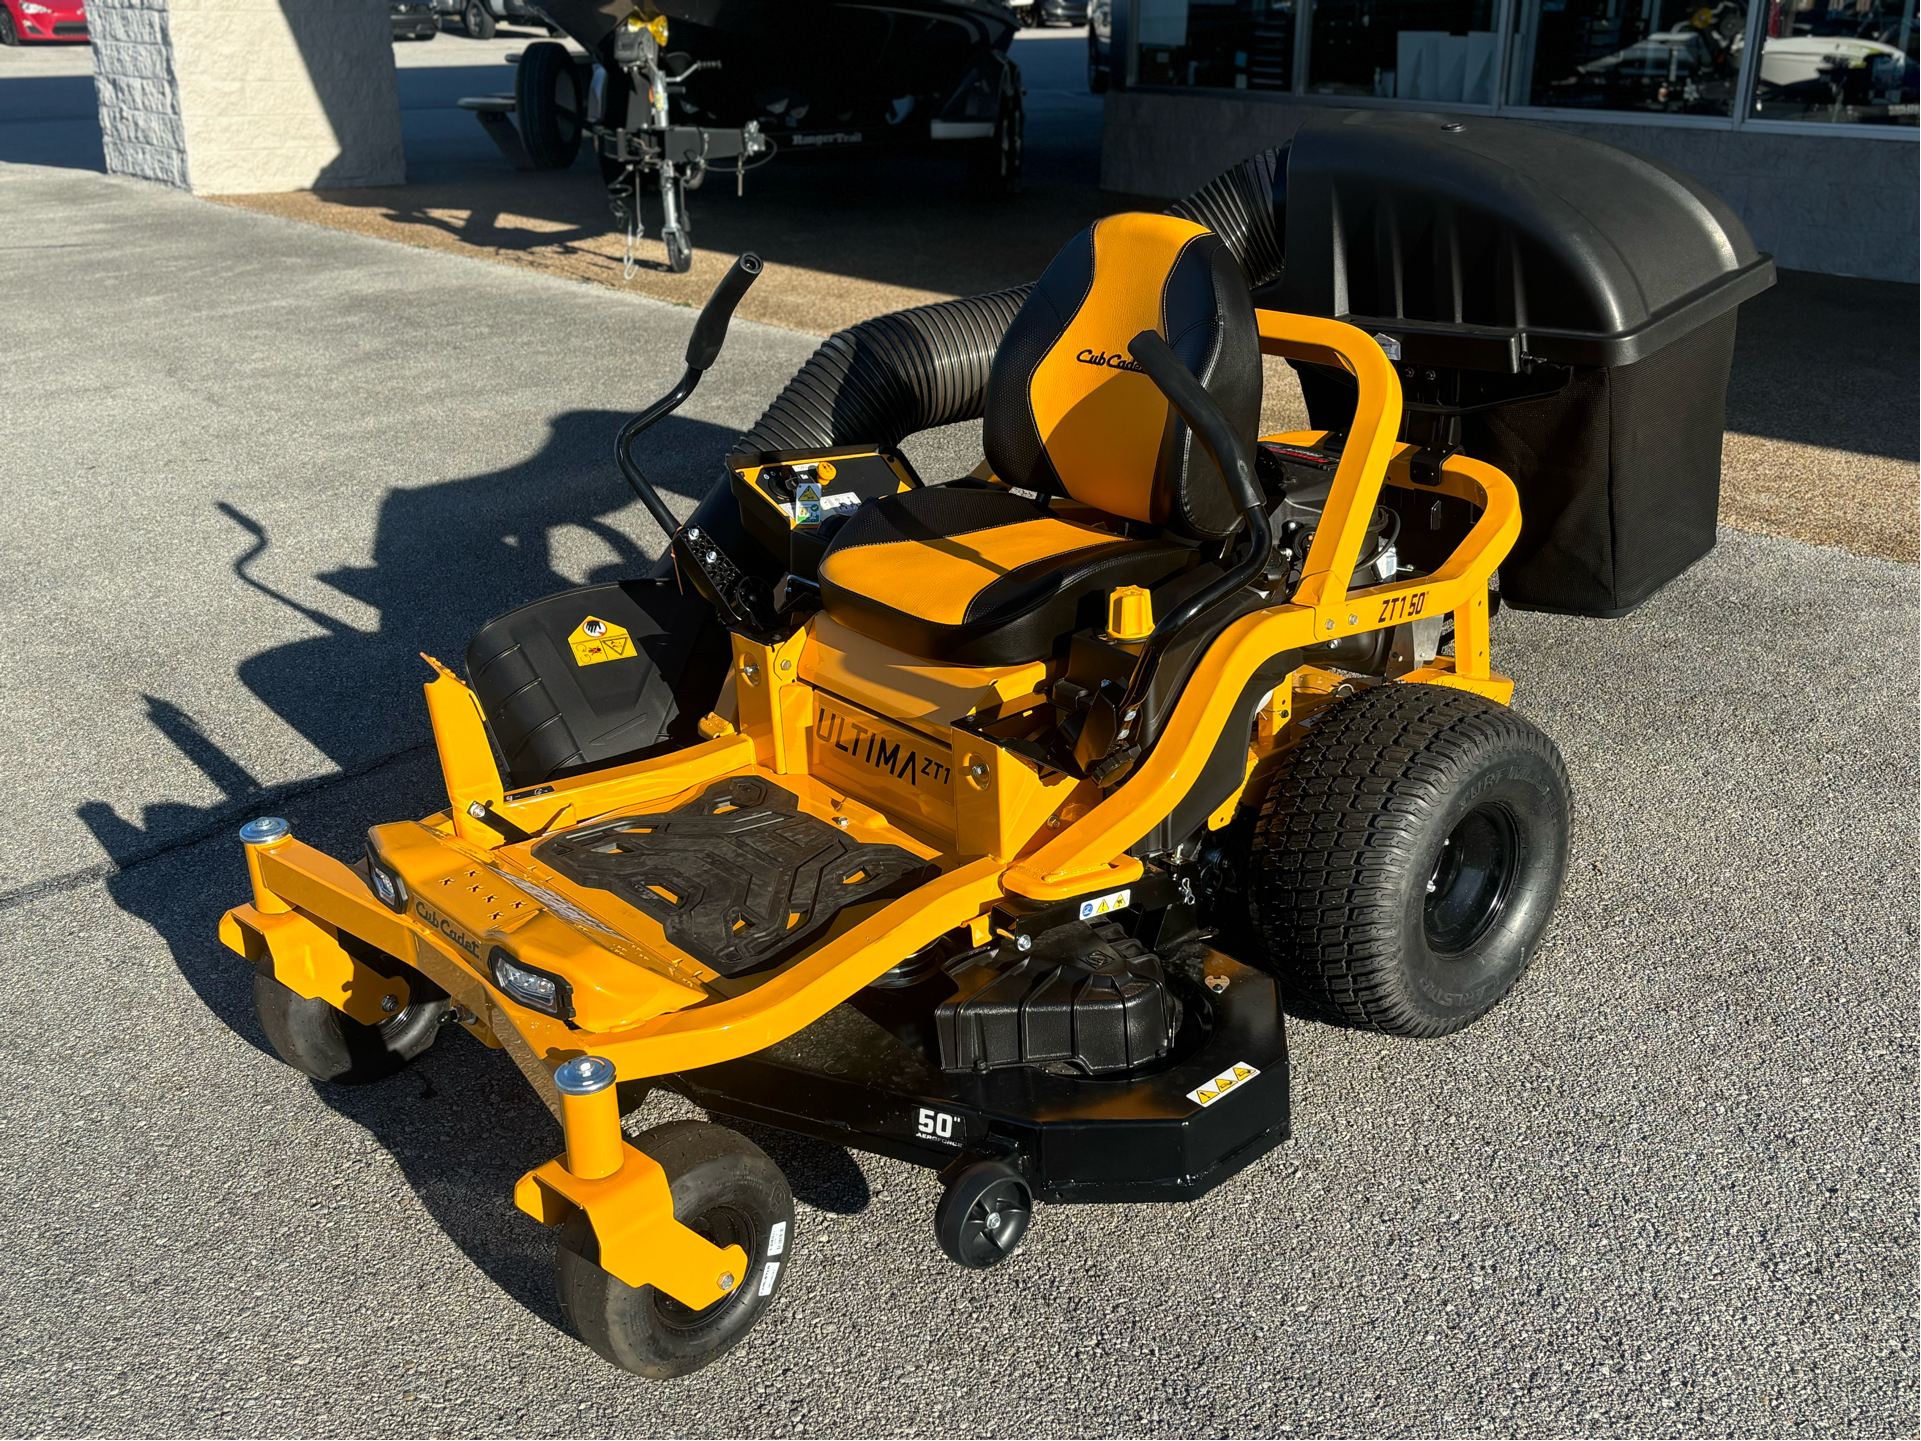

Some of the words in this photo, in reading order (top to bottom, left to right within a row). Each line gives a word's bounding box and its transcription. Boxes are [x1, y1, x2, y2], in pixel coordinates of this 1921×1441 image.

[1077, 349, 1106, 366] Cub
[1107, 354, 1146, 374] Cade
[1378, 596, 1407, 623] ZT1
[816, 708, 916, 786] ULTIMA
[921, 757, 951, 785] ZT1
[416, 901, 439, 928] Cub
[440, 919, 480, 959] Cadet
[918, 1108, 961, 1138] 50"
[916, 1132, 964, 1148] AEROFORCE
